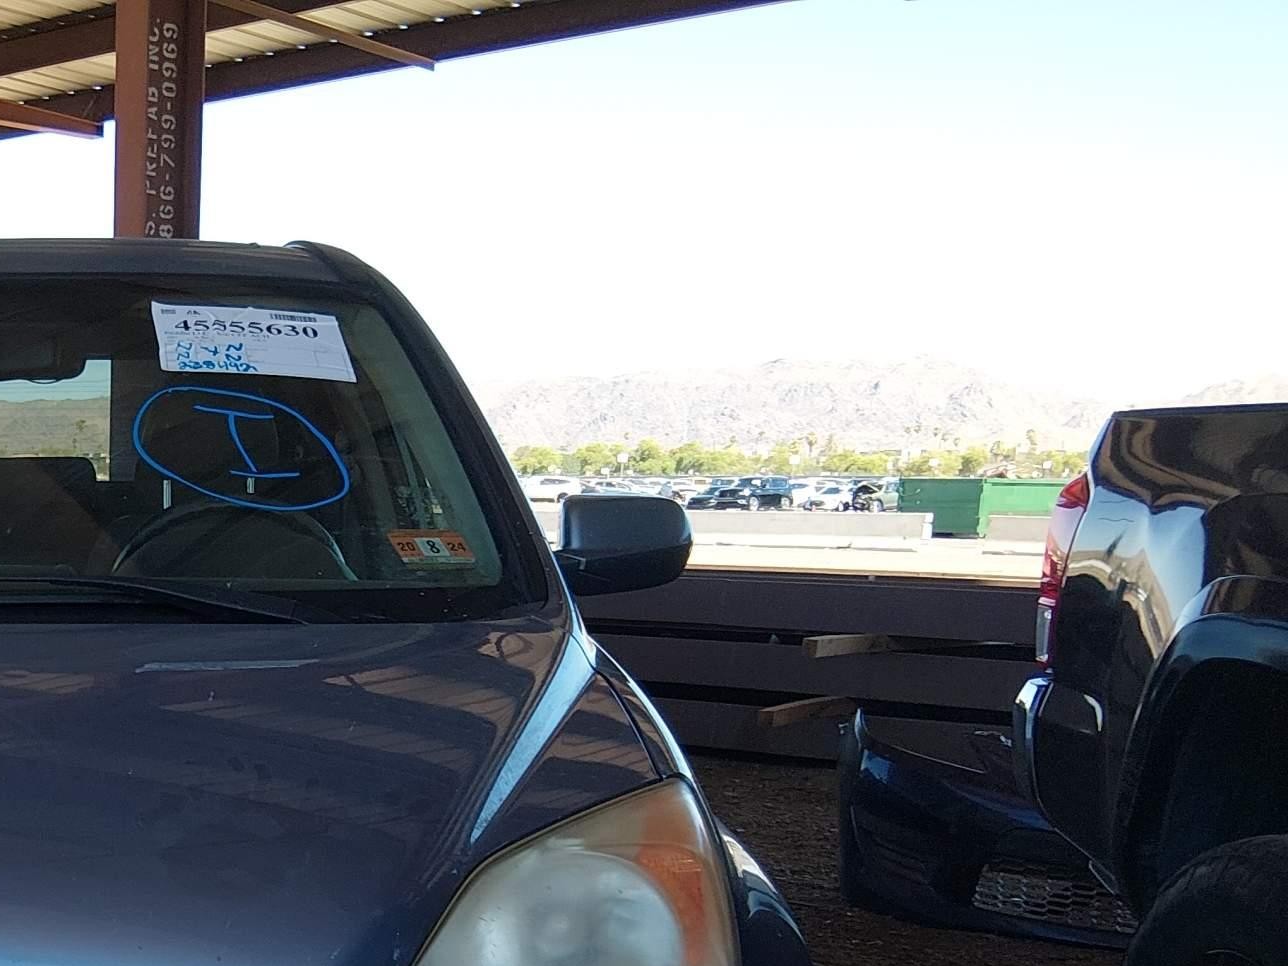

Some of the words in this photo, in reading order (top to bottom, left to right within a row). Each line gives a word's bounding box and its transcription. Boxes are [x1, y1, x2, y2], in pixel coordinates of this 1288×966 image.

[174, 319, 318, 339] 45555630
[397, 541, 416, 552] 20
[425, 540, 441, 554] 8
[446, 541, 468, 552] 24
